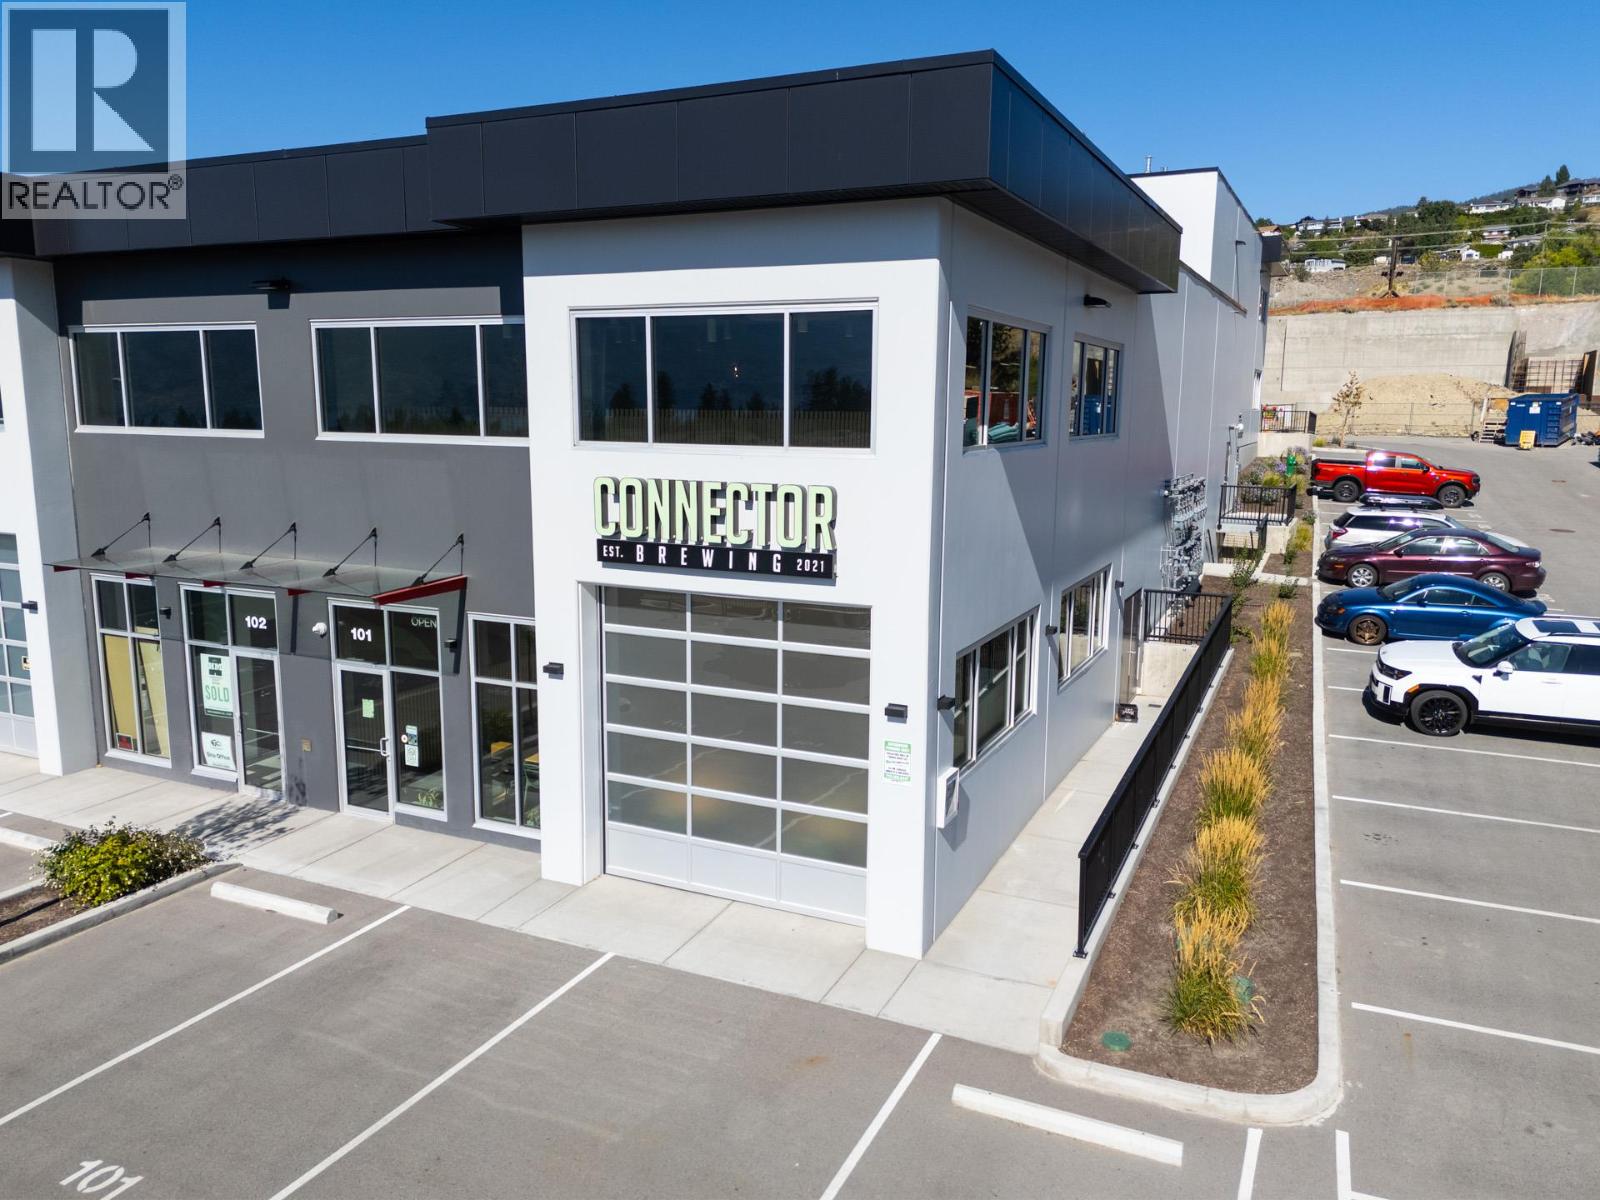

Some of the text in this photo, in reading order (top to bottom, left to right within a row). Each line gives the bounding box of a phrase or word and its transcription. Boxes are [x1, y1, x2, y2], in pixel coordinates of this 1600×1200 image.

[593, 476, 837, 552] CONNECTOR
[602, 544, 825, 573] EST. BREWING 2021
[245, 615, 268, 630] 102
[410, 615, 437, 629] OPEN
[350, 627, 373, 642] 101
[205, 684, 230, 702] SOLD
[59, 1159, 144, 1200] 101
